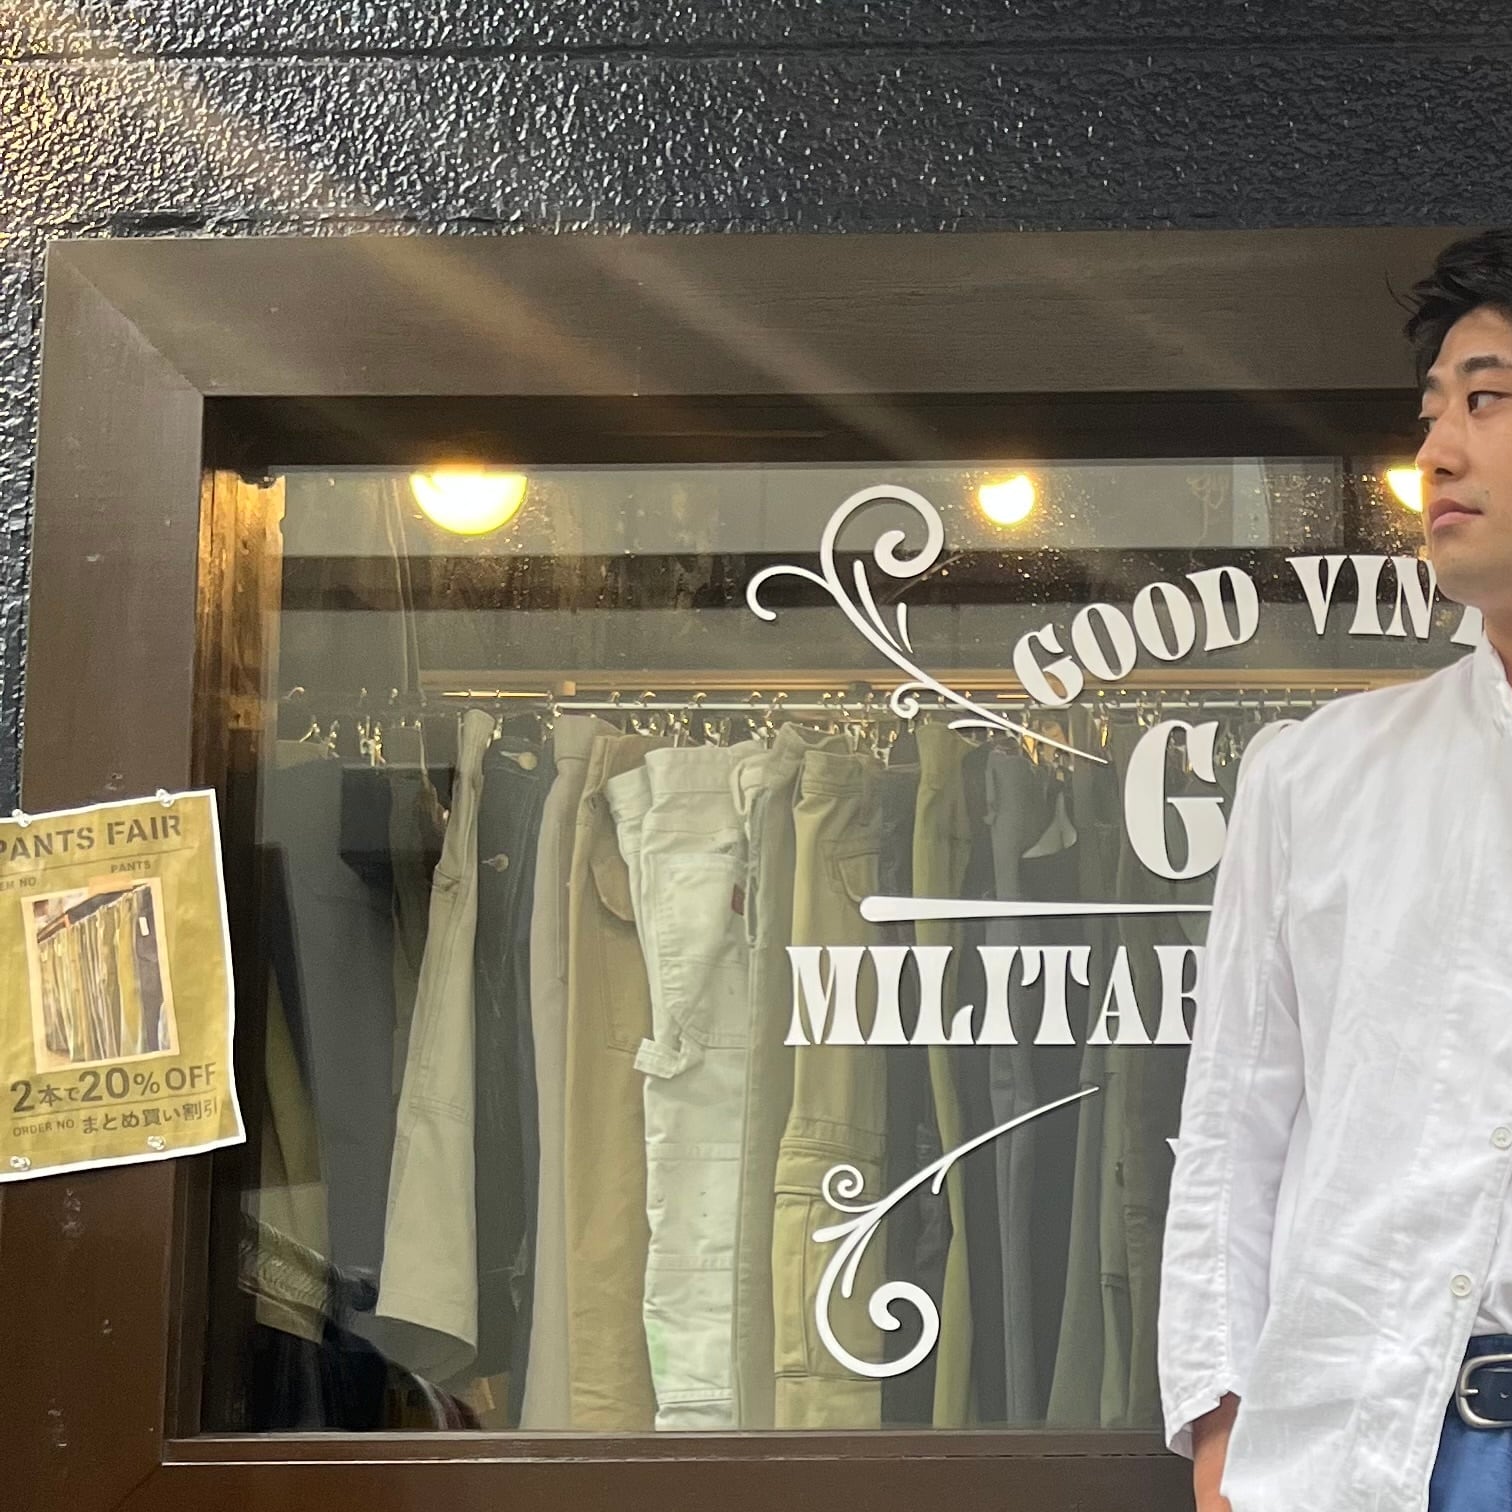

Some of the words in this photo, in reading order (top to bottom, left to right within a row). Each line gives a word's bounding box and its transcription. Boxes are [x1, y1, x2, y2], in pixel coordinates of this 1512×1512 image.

[1013, 566, 1259, 706] GOOD
[107, 815, 181, 845] FAIR
[111, 860, 151, 873] PANTS
[784, 945, 1207, 1045] MILITAR
[13, 1121, 52, 1137] ORDER
[82, 1096, 217, 1135] まとめ買い割引
